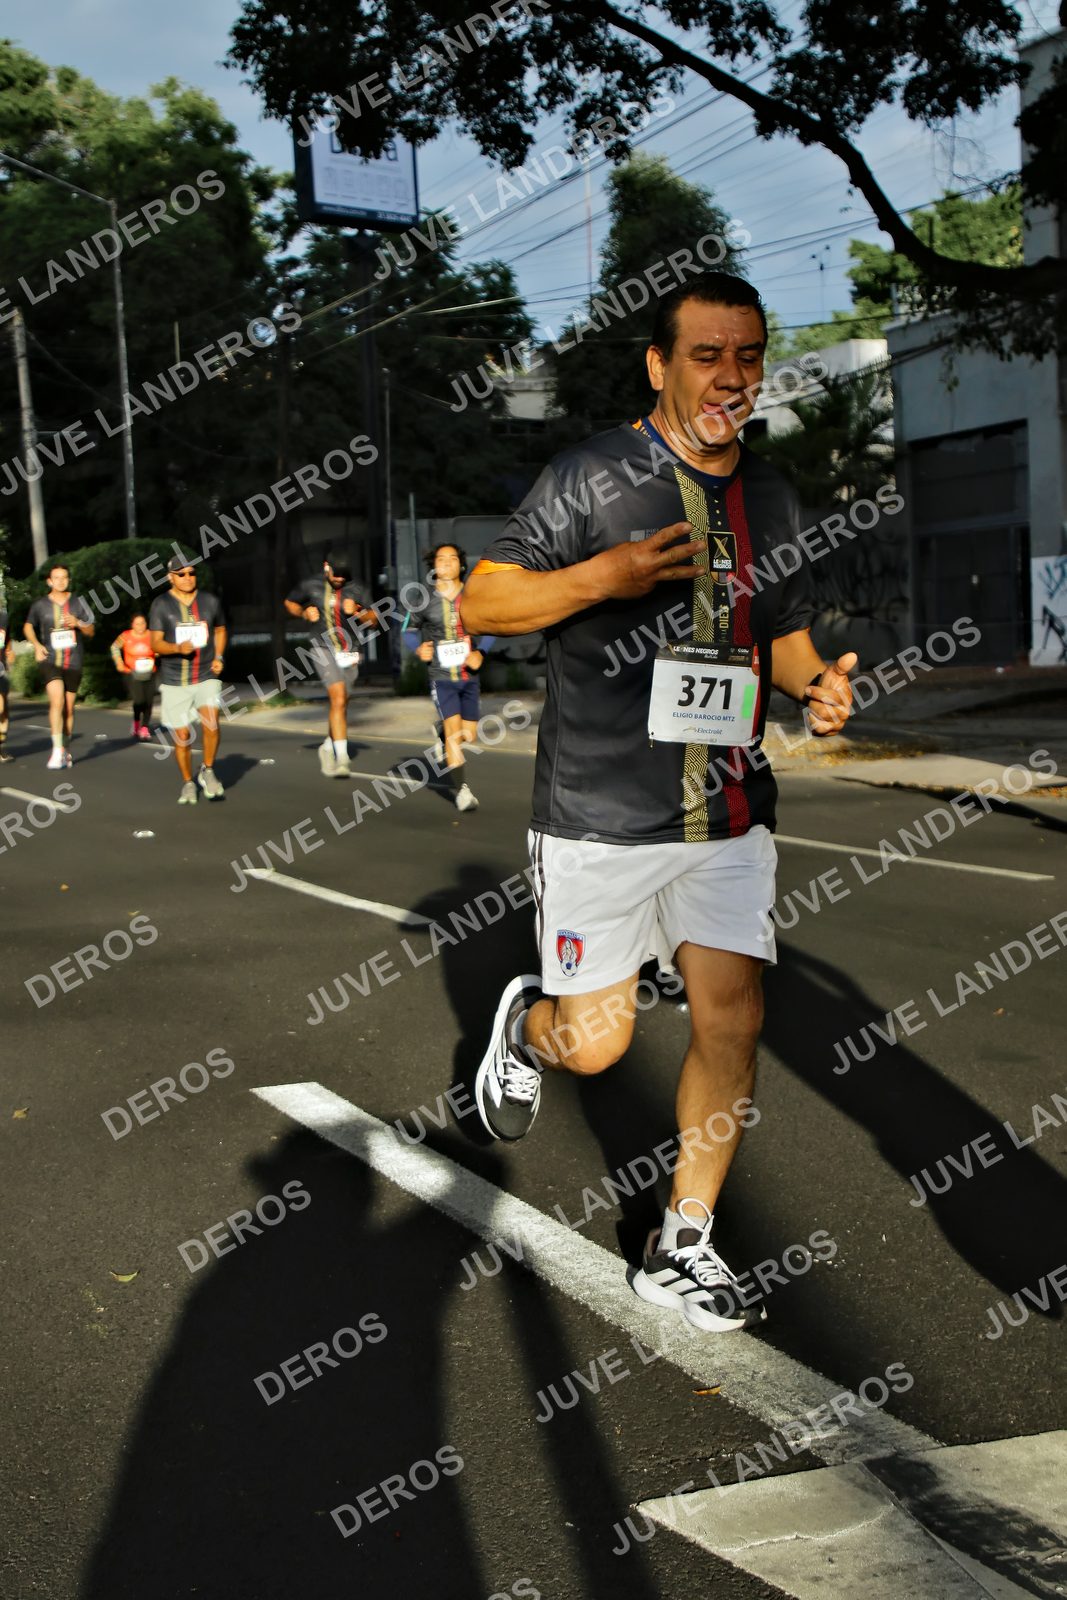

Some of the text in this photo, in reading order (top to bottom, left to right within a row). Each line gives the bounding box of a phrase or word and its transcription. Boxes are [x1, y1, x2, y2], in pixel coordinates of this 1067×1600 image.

[673, 645, 719, 655] LENES NEGROS
[677, 674, 733, 710] 371
[694, 713, 721, 721] BAROCIO
